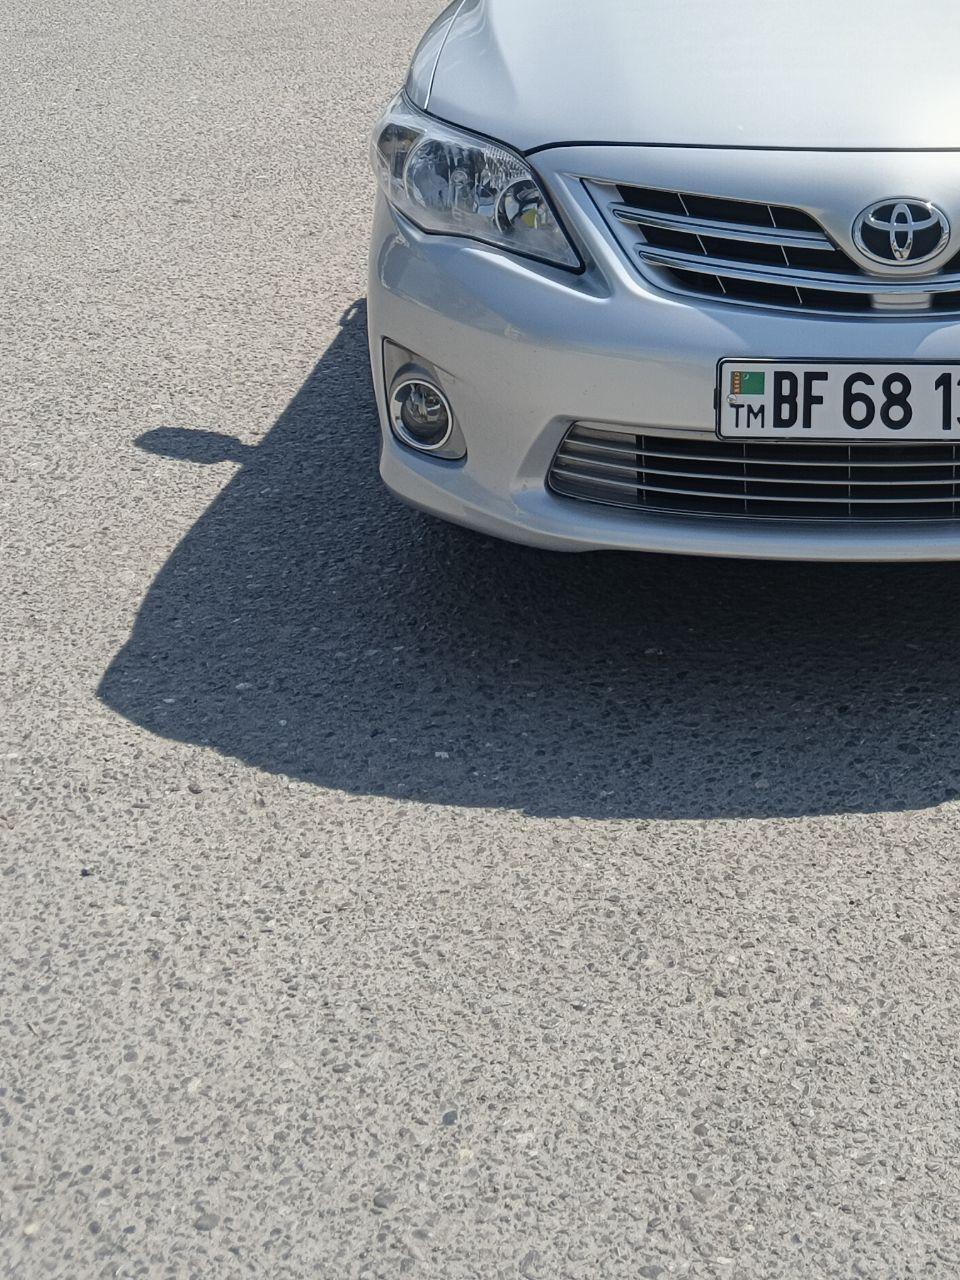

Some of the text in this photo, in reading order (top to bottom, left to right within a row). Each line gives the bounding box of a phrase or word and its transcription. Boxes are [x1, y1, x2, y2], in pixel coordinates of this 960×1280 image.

[733, 404, 765, 428] TM
[773, 371, 828, 428] BF
[842, 371, 913, 430] 68
